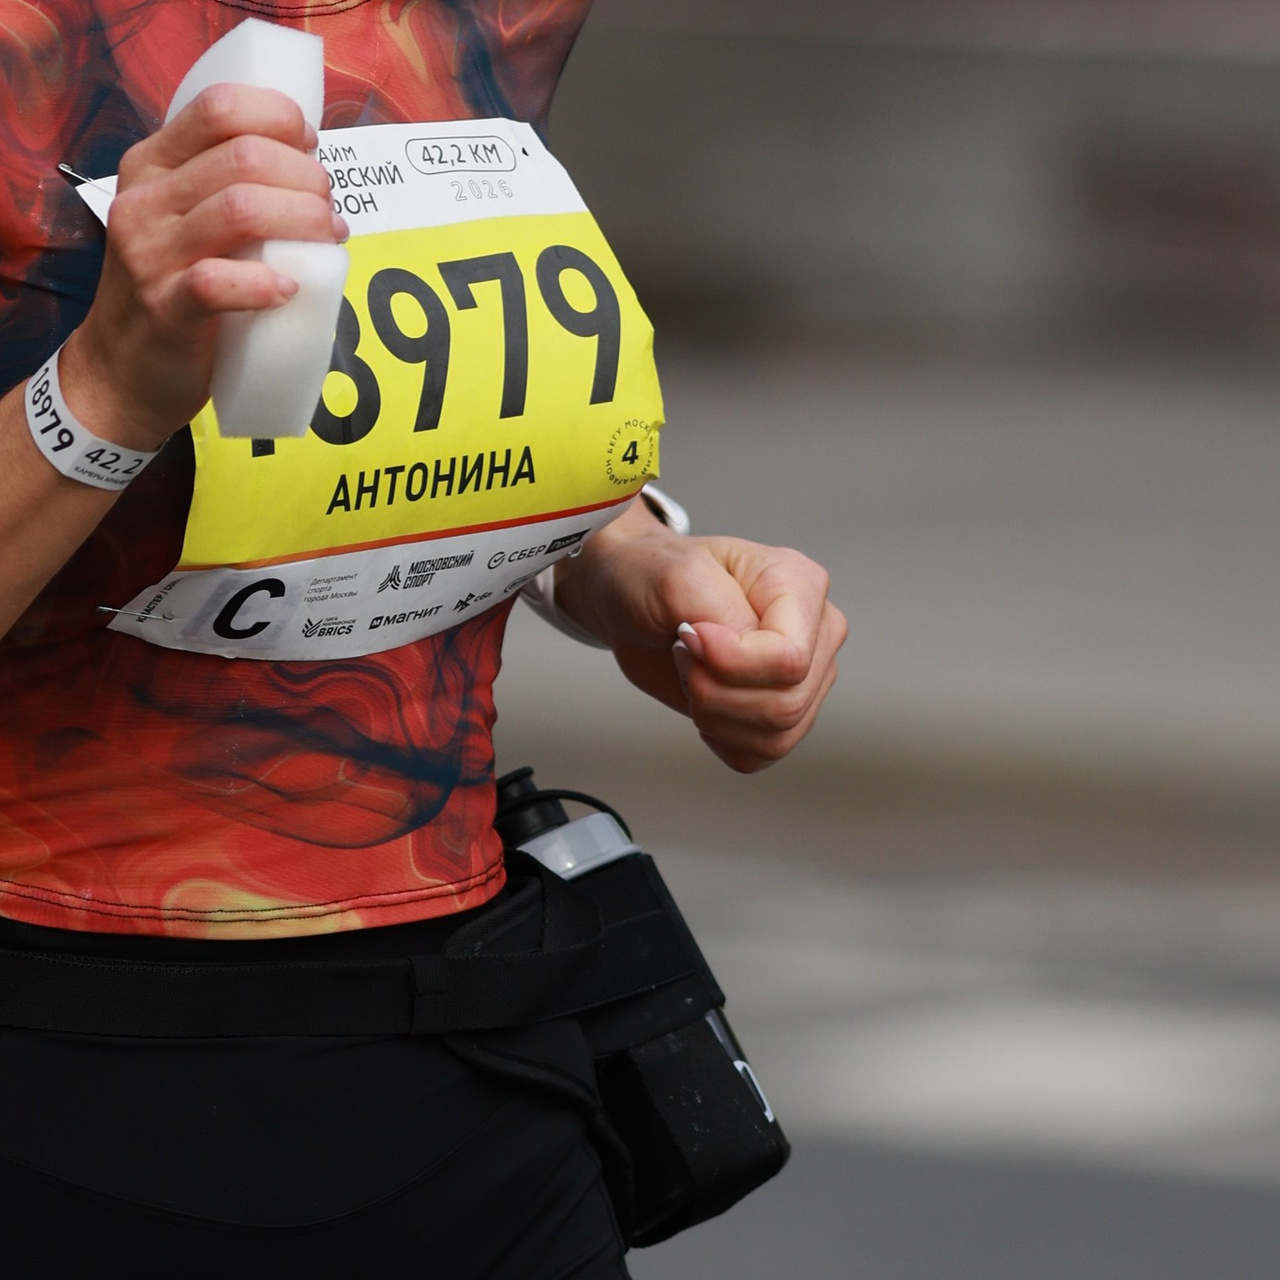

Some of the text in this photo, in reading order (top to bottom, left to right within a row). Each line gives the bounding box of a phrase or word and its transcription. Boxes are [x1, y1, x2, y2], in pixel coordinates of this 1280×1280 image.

[319, 144, 358, 164] АЙМ
[421, 143, 467, 167] 42,2
[451, 179, 514, 202] 2026
[251, 244, 621, 458] 8979
[31, 366, 75, 453] 18979
[85, 448, 144, 475] 42,2
[622, 440, 640, 466] 4
[325, 445, 536, 516] АНТОНИНА
[408, 549, 475, 576] МОСКОВСКИЙ
[507, 543, 547, 564] СБЕР
[402, 572, 436, 590] СПОРТ
[317, 624, 354, 638] BRICS
